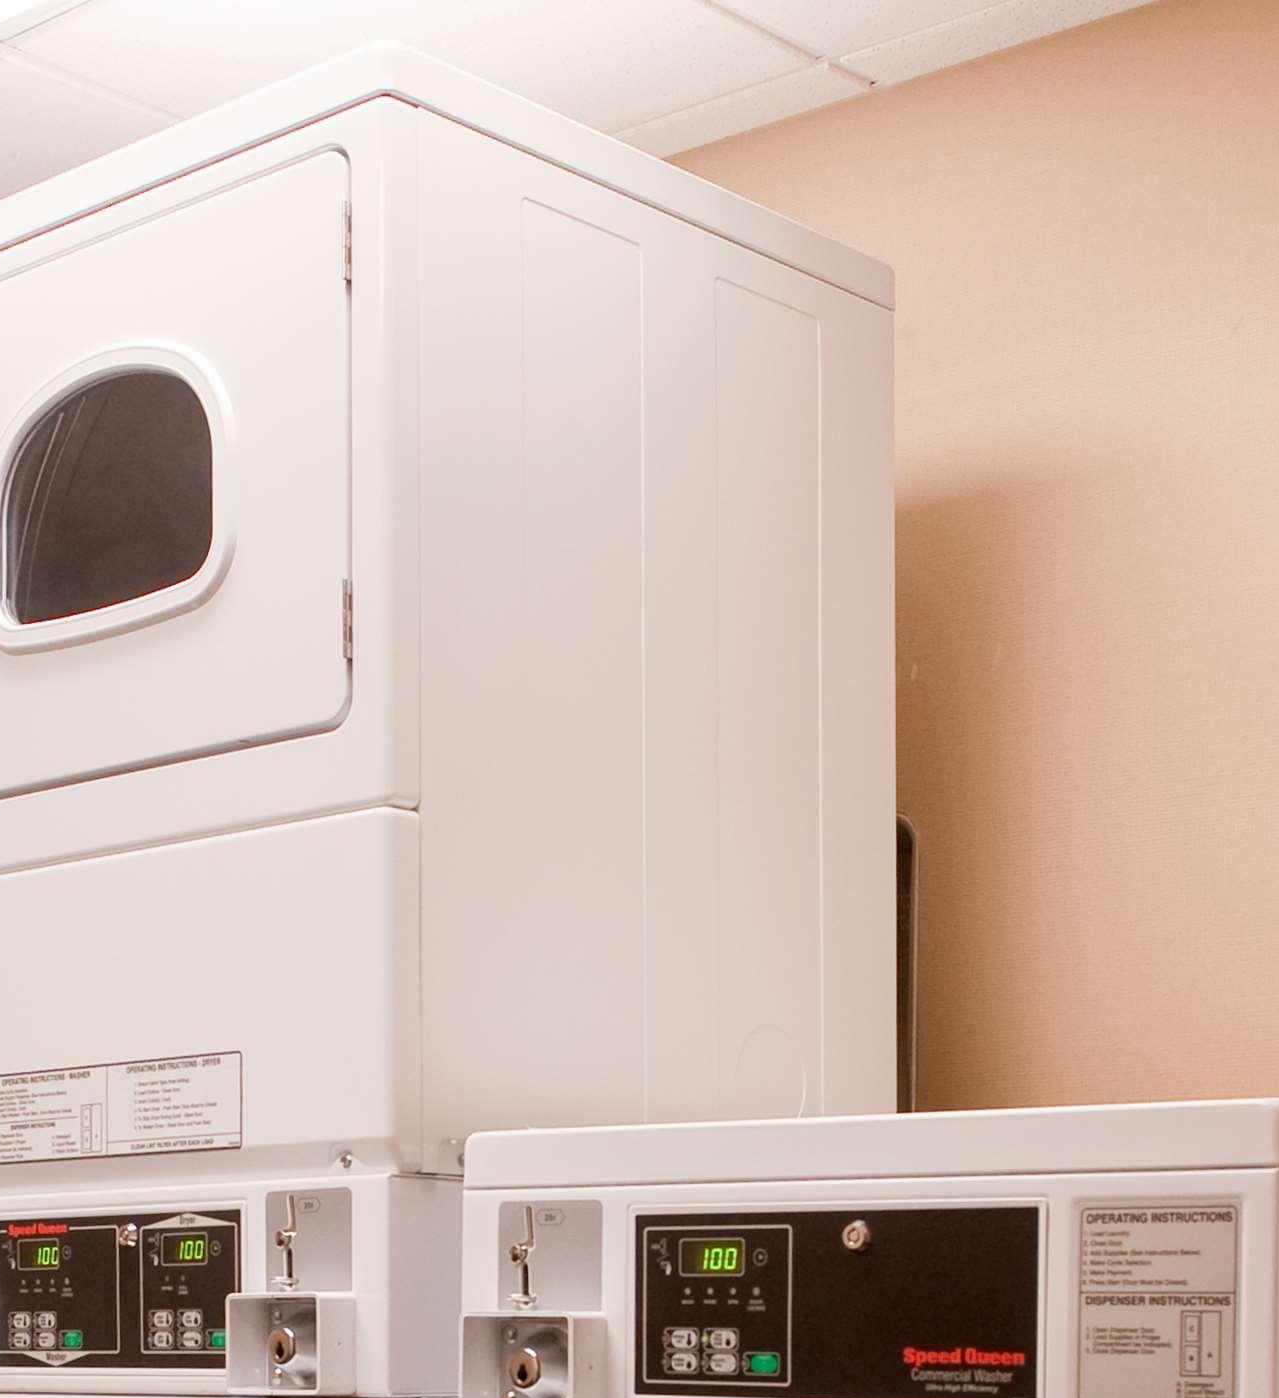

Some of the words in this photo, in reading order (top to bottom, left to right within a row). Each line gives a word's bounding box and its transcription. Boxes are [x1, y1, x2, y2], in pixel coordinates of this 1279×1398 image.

[1087, 1213, 1147, 1224] OPERATING
[1151, 1211, 1233, 1223] INSTRUCTIONS
[8, 1223, 37, 1238] Speed
[38, 1222, 68, 1235] Queen
[37, 1246, 59, 1265] 100
[180, 1240, 204, 1260] 100
[703, 1247, 738, 1270] 100
[1085, 1296, 1146, 1306] DISPENSER
[1149, 1296, 1231, 1306] INSTRUCTIONS
[903, 1347, 961, 1367] Speed
[965, 1347, 1025, 1366] Queen
[911, 1367, 972, 1382] Commercial
[974, 1369, 1013, 1382] Washer
